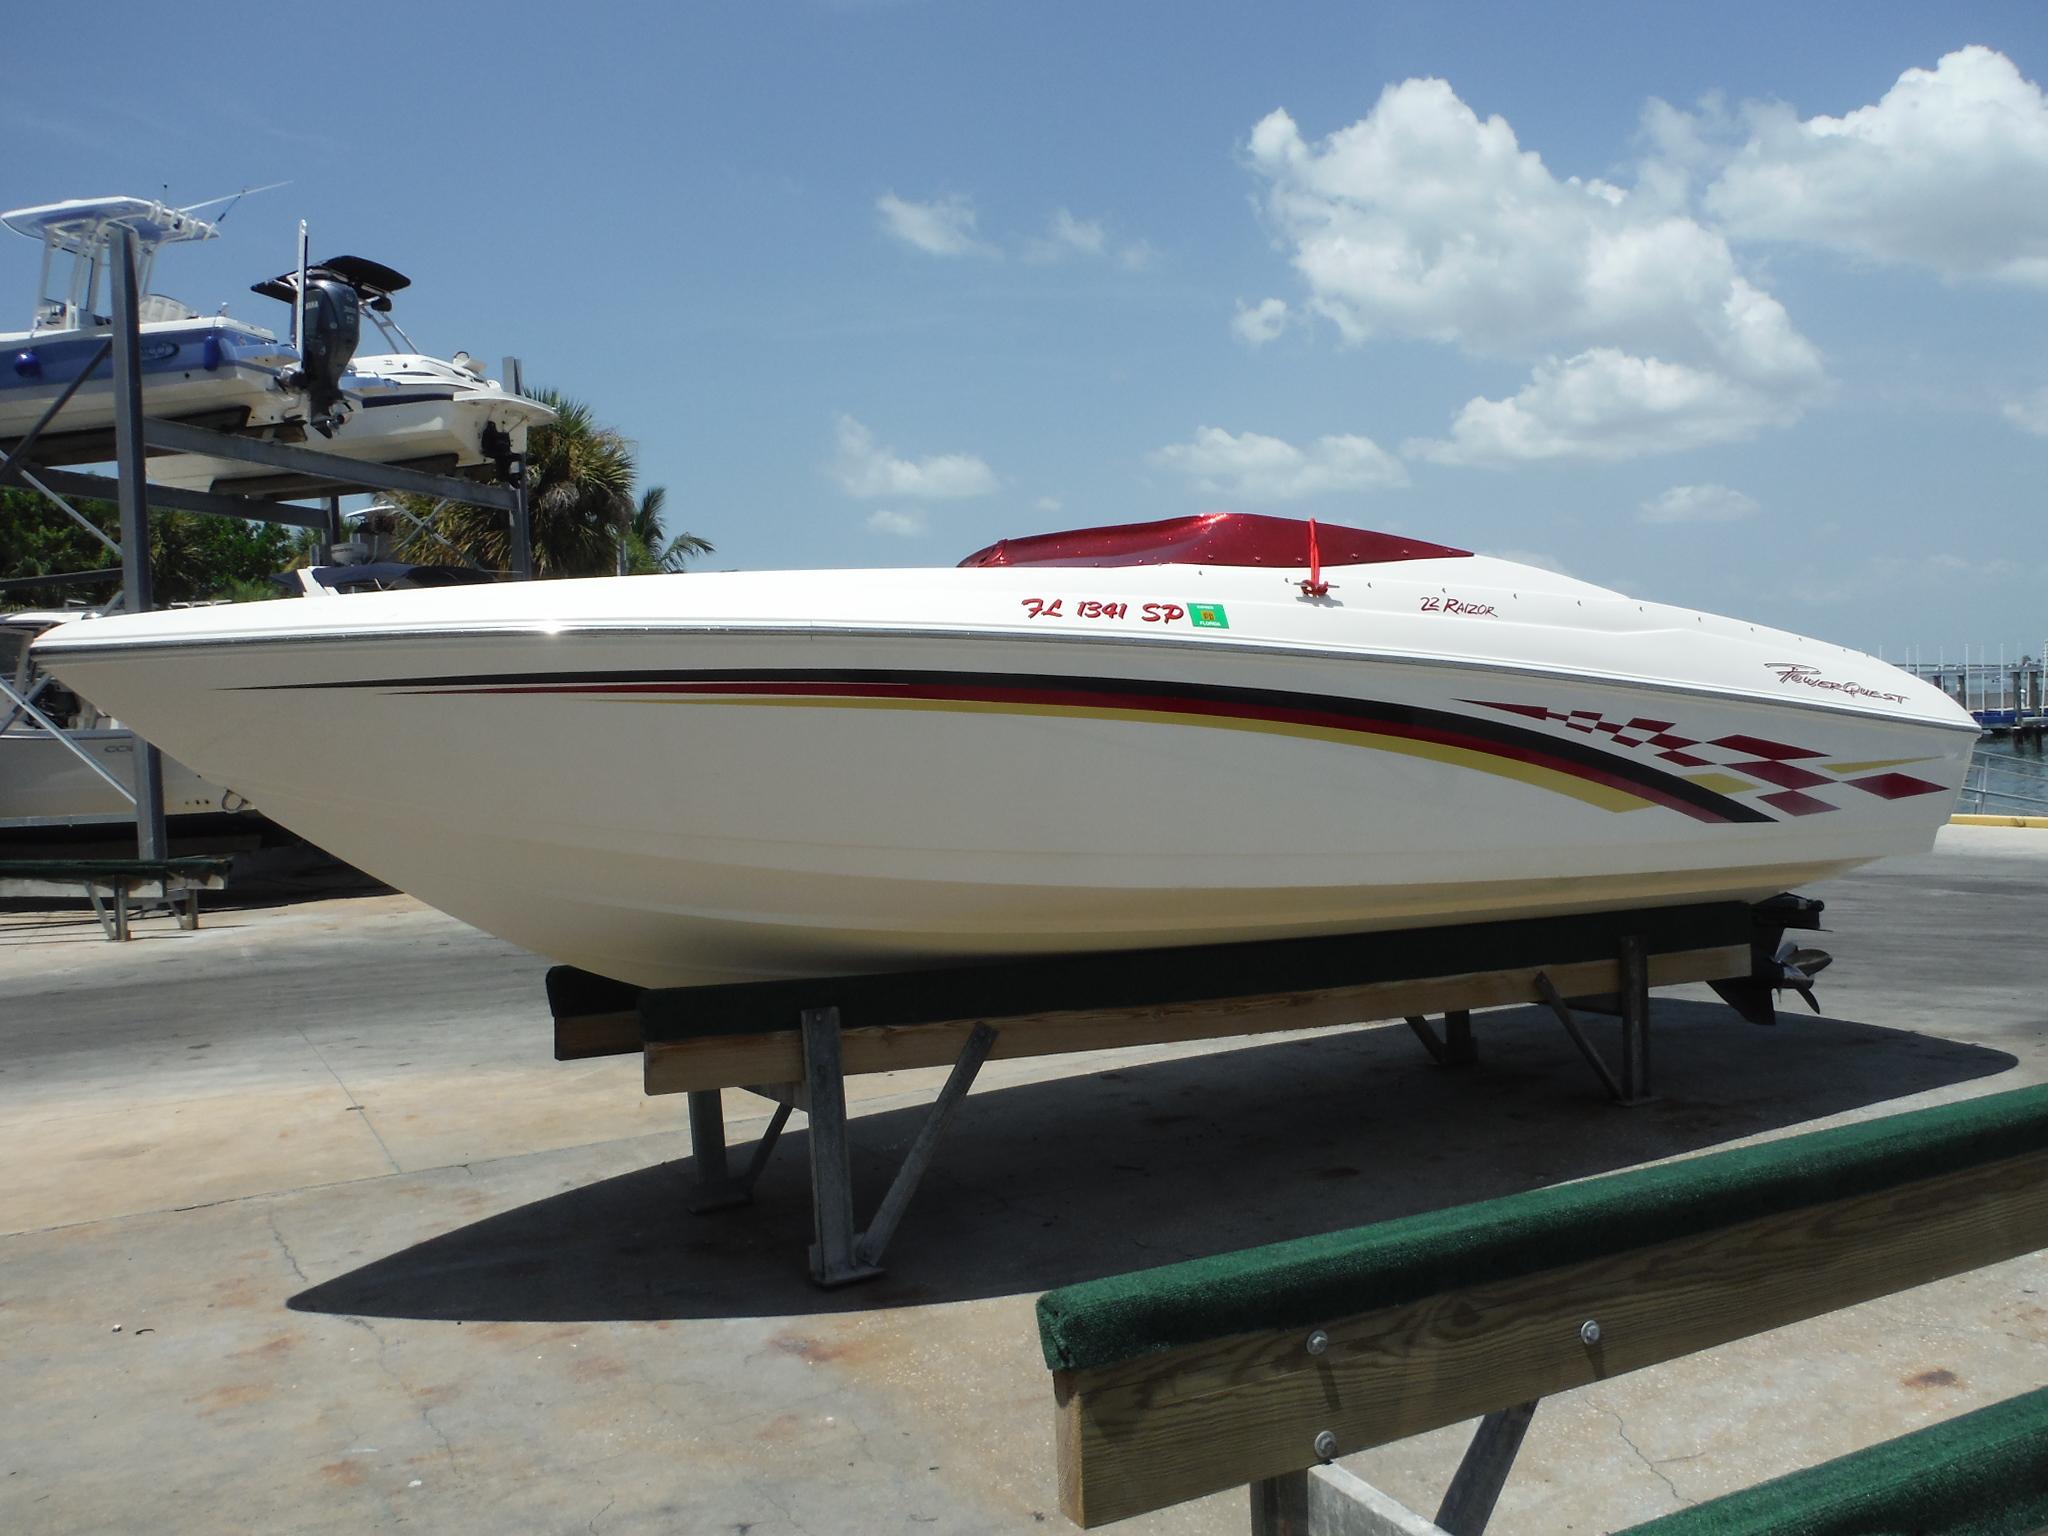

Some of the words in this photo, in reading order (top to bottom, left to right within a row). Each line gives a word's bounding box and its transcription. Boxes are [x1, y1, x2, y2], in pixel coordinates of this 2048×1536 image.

[1021, 598, 1063, 619] FL
[1077, 601, 1128, 619] 1341
[1141, 603, 1185, 624] SP
[1420, 597, 1440, 611] 22
[1443, 598, 1498, 617] RAIZOR
